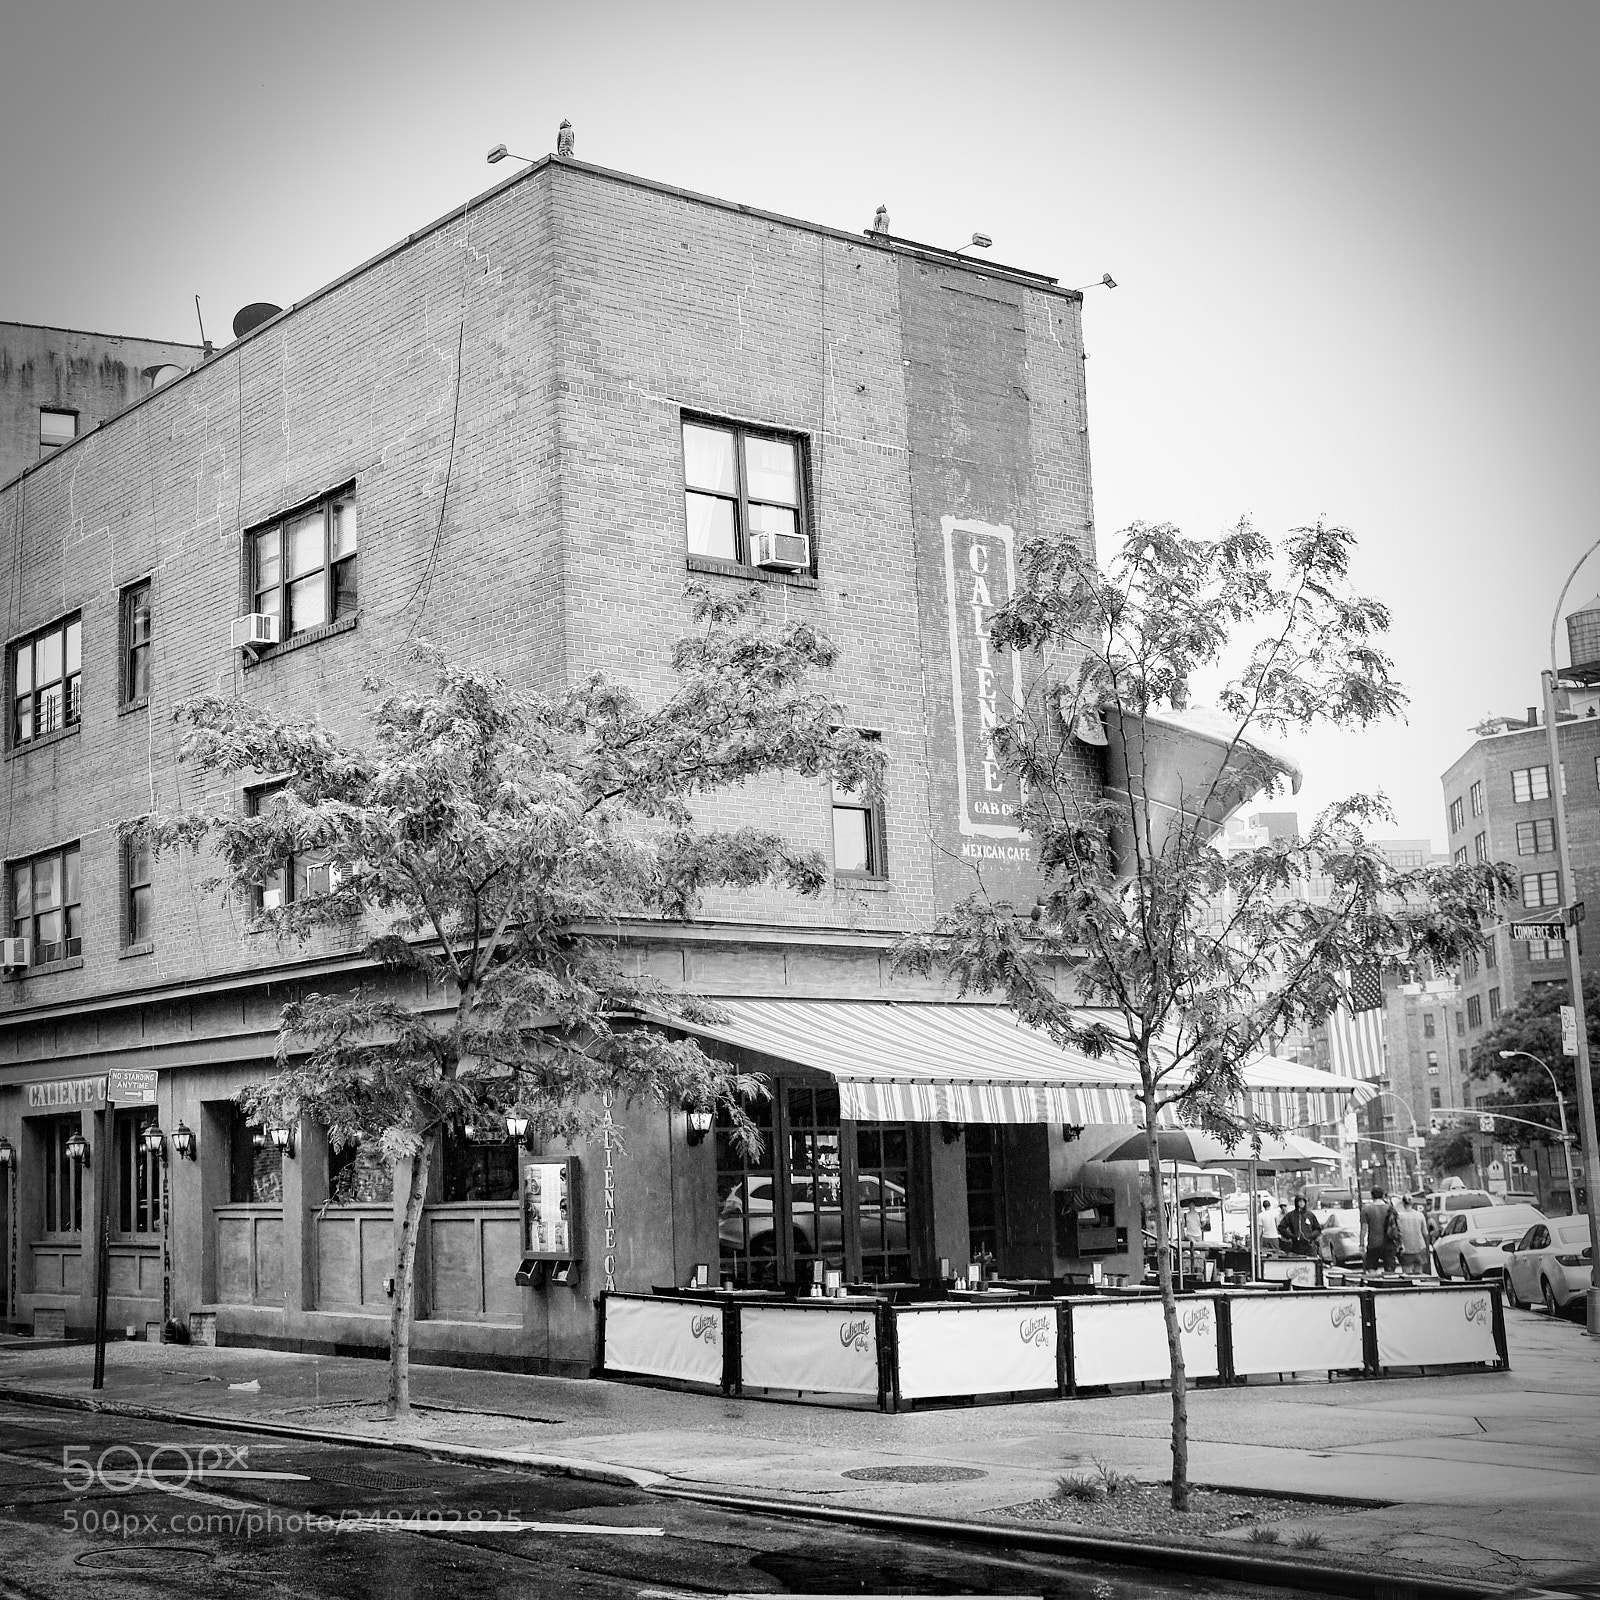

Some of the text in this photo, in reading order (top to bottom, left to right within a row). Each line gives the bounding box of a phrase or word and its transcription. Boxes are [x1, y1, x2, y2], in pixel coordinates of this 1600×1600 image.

[969, 544, 1003, 792] CALIENTE
[974, 801, 1000, 815] CAB
[962, 843, 1031, 861] MEXICAN CAFE
[1513, 925, 1562, 940] COMMERCE ST
[112, 1072, 155, 1082] NO STANDING
[28, 1079, 94, 1108] CALIENTE
[116, 1081, 149, 1090] ANYTIME
[602, 1086, 617, 1250] CALIENTE
